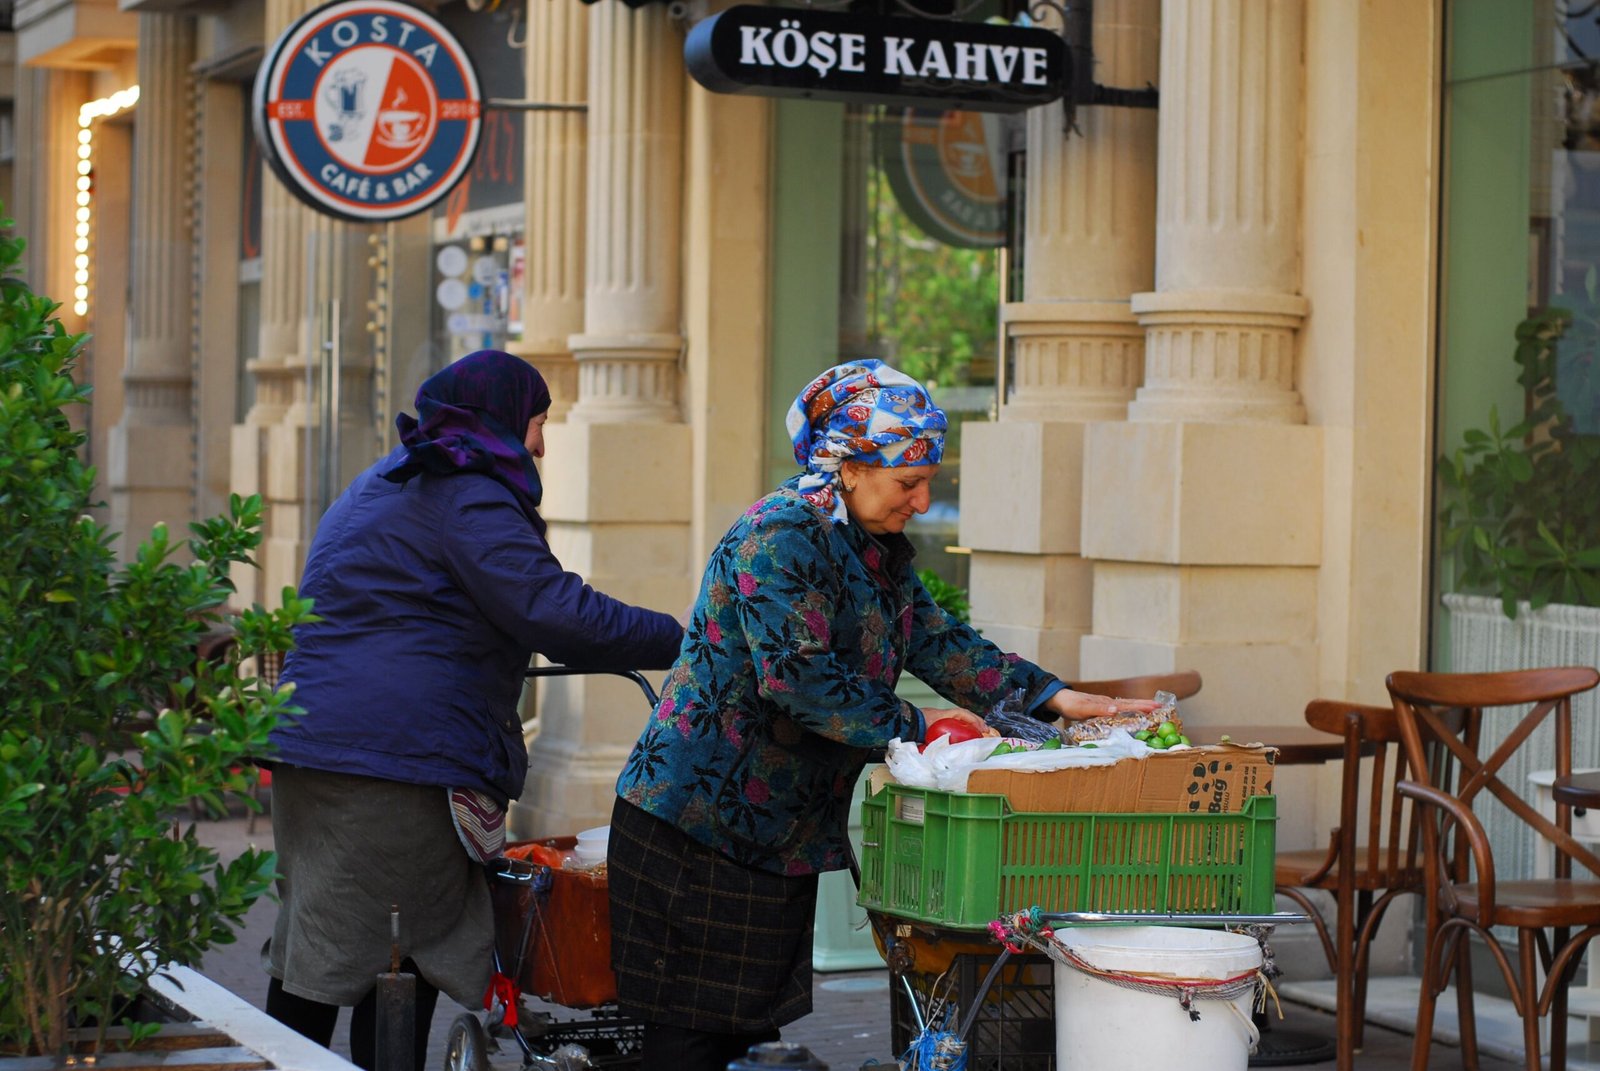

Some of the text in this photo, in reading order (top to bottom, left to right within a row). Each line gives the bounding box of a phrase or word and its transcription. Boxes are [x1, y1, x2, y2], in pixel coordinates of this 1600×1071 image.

[304, 16, 438, 67] KOSTA
[739, 19, 1047, 85] KÖŞE KAHVE
[321, 163, 433, 200] CAFÉ & BAR
